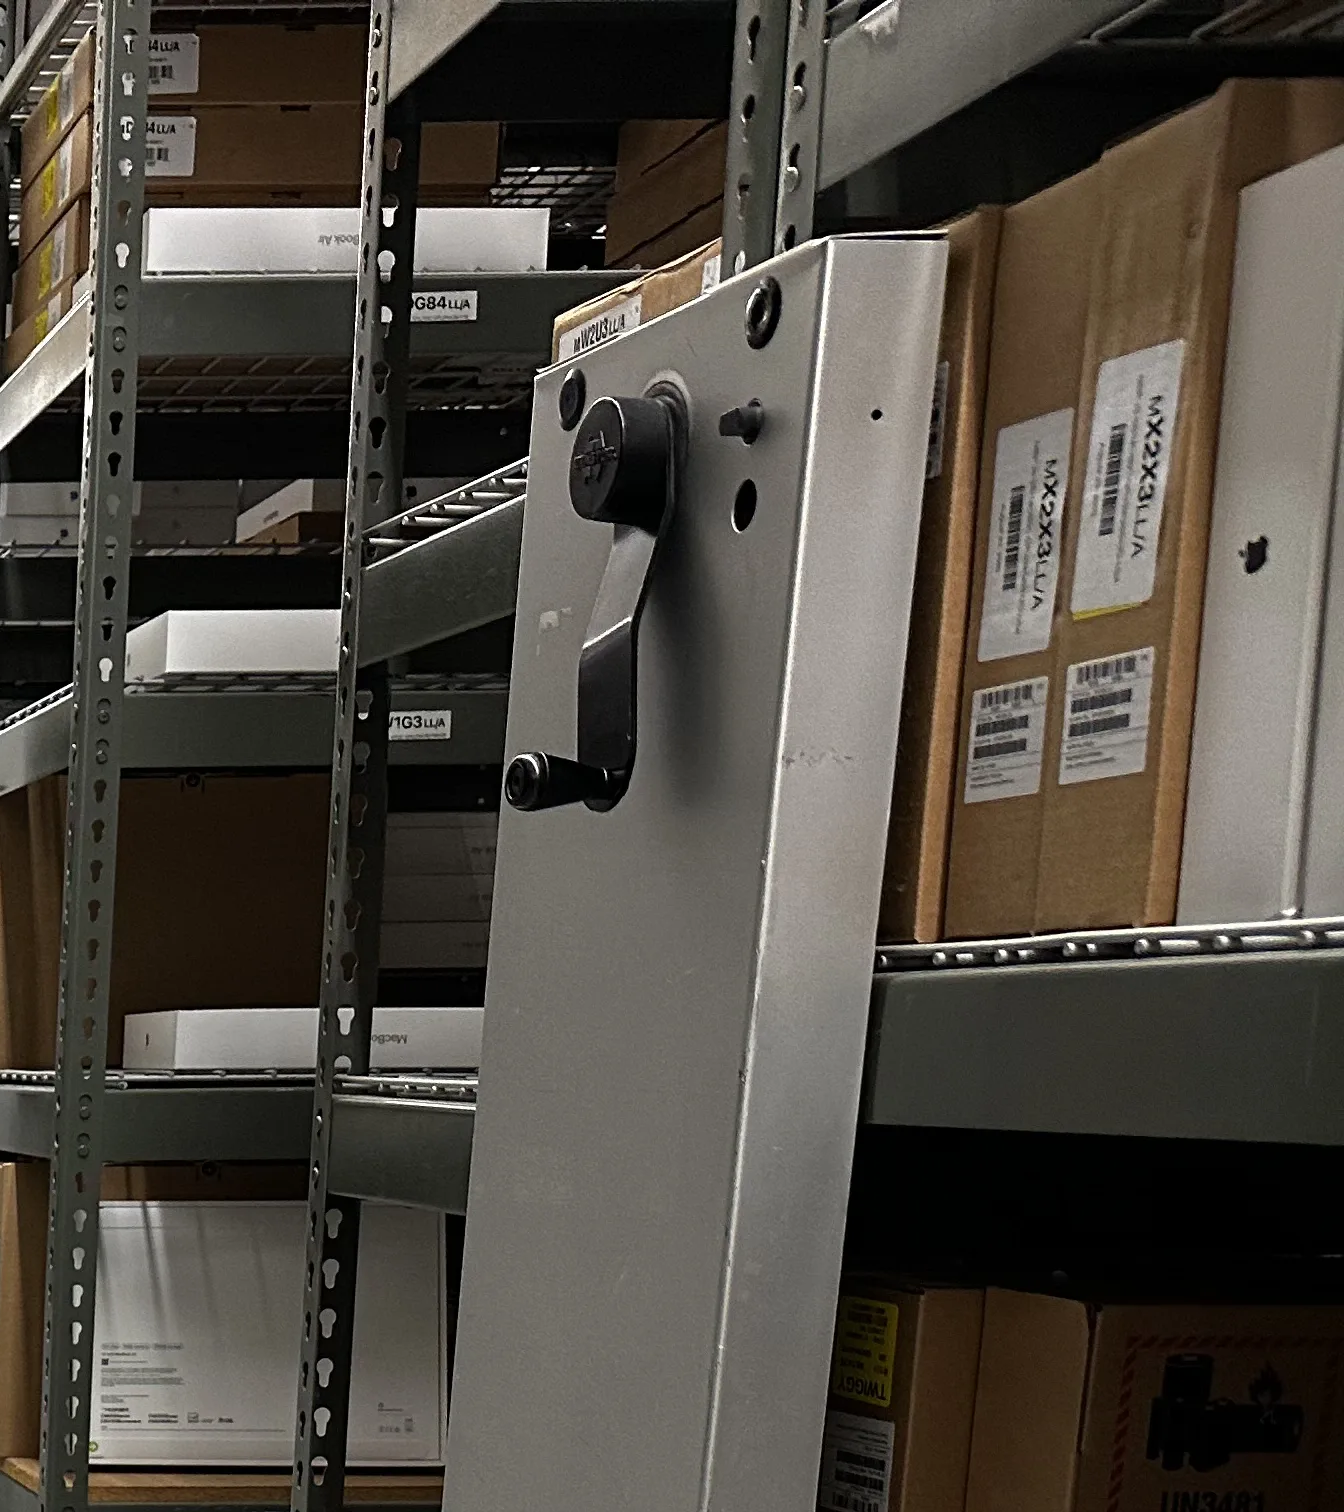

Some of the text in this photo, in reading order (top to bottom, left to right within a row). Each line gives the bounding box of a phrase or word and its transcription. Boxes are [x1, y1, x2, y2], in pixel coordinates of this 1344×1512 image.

[413, 296, 470, 310] G84LL/A
[1130, 395, 1164, 559] MX2X3LL/A
[1031, 459, 1059, 611] MX2X3LL/A
[391, 715, 446, 730] 1G3LL/A
[372, 1033, 408, 1045] MacBo
[837, 1373, 887, 1401] TWIGGY
